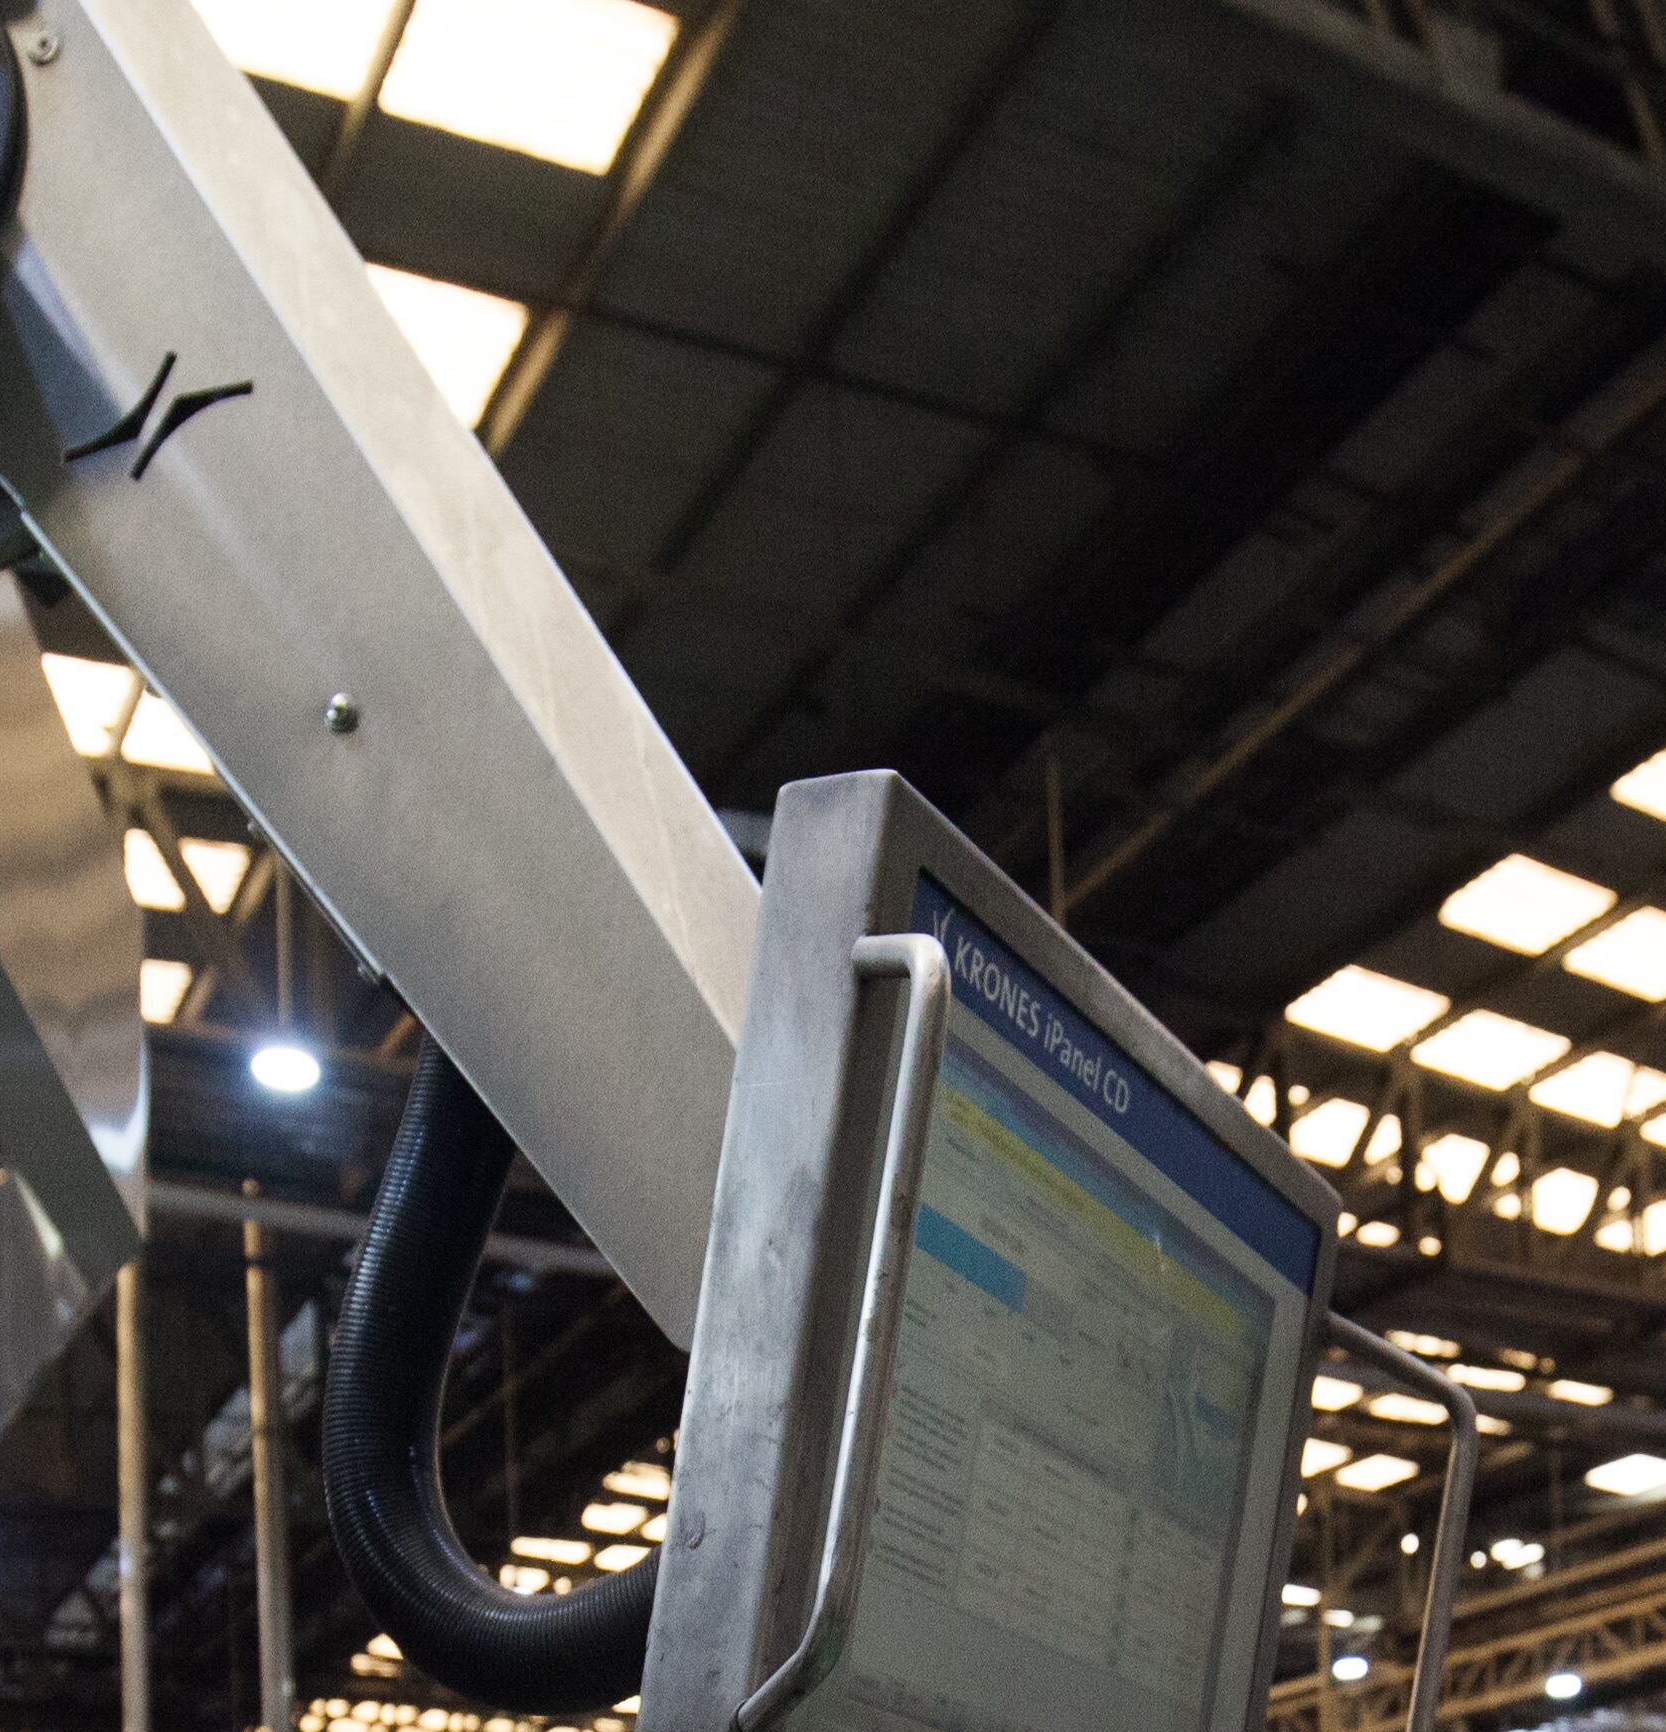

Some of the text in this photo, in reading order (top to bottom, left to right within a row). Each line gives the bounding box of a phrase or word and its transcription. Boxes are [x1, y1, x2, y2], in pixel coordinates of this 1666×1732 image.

[954, 935, 1130, 1114] KRONES iPanel CD
